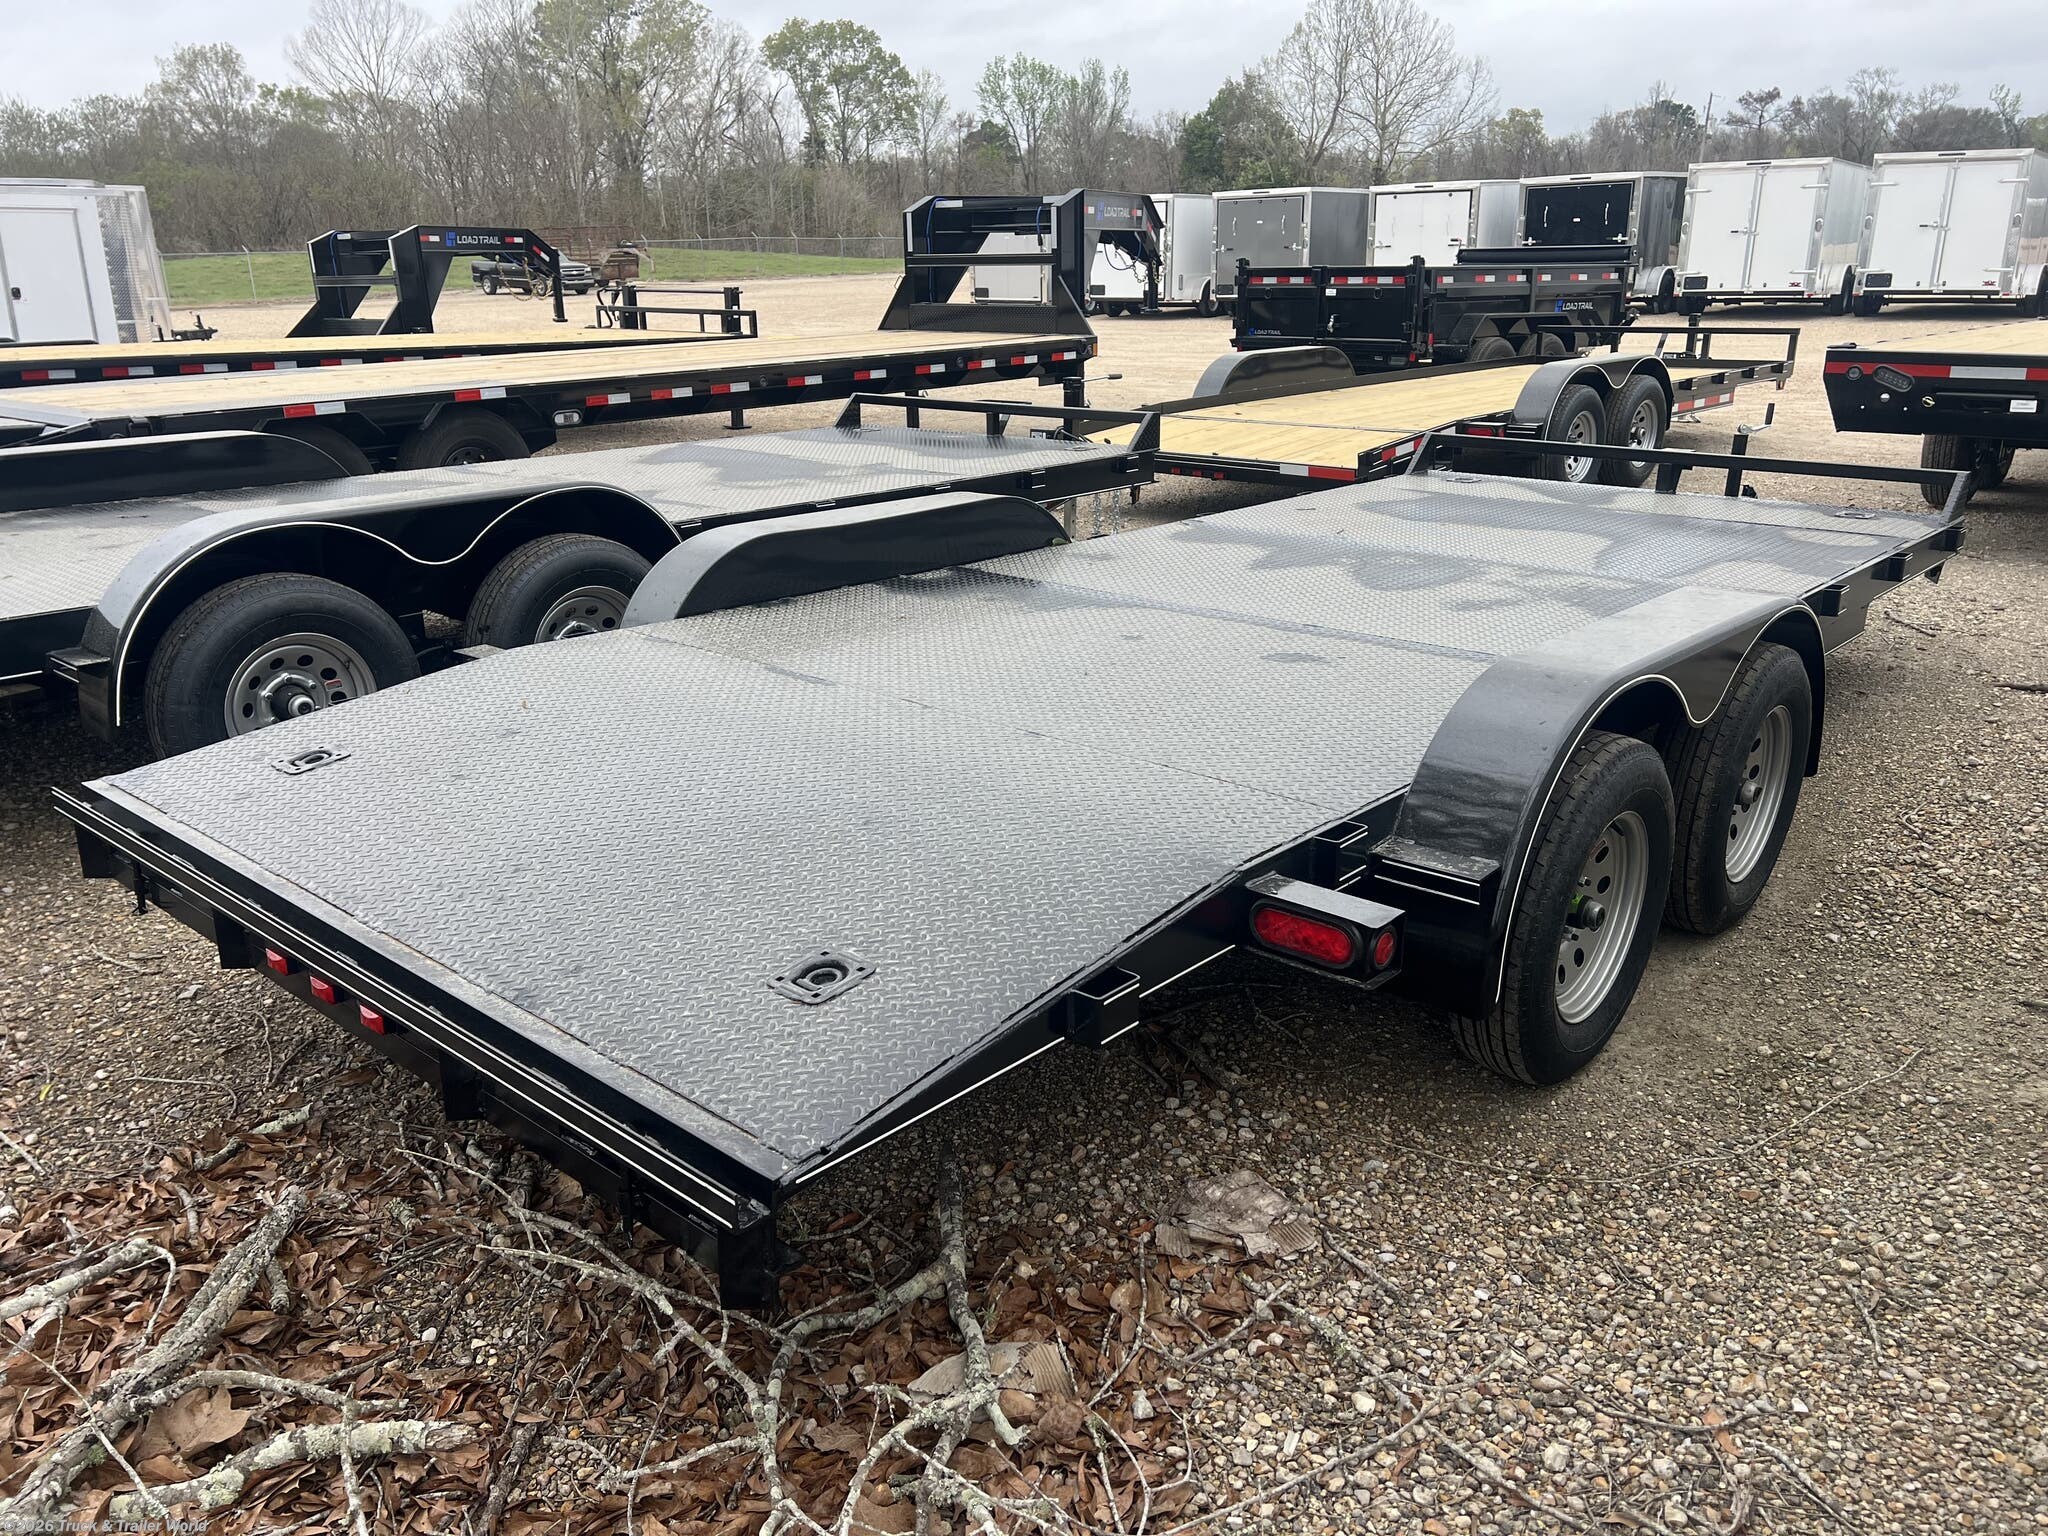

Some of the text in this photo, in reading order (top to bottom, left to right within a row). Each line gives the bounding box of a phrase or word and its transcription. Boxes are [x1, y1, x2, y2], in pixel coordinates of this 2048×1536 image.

[456, 235, 501, 245] LOAD TRAIL
[1562, 302, 1593, 311] LOAD TRAIL
